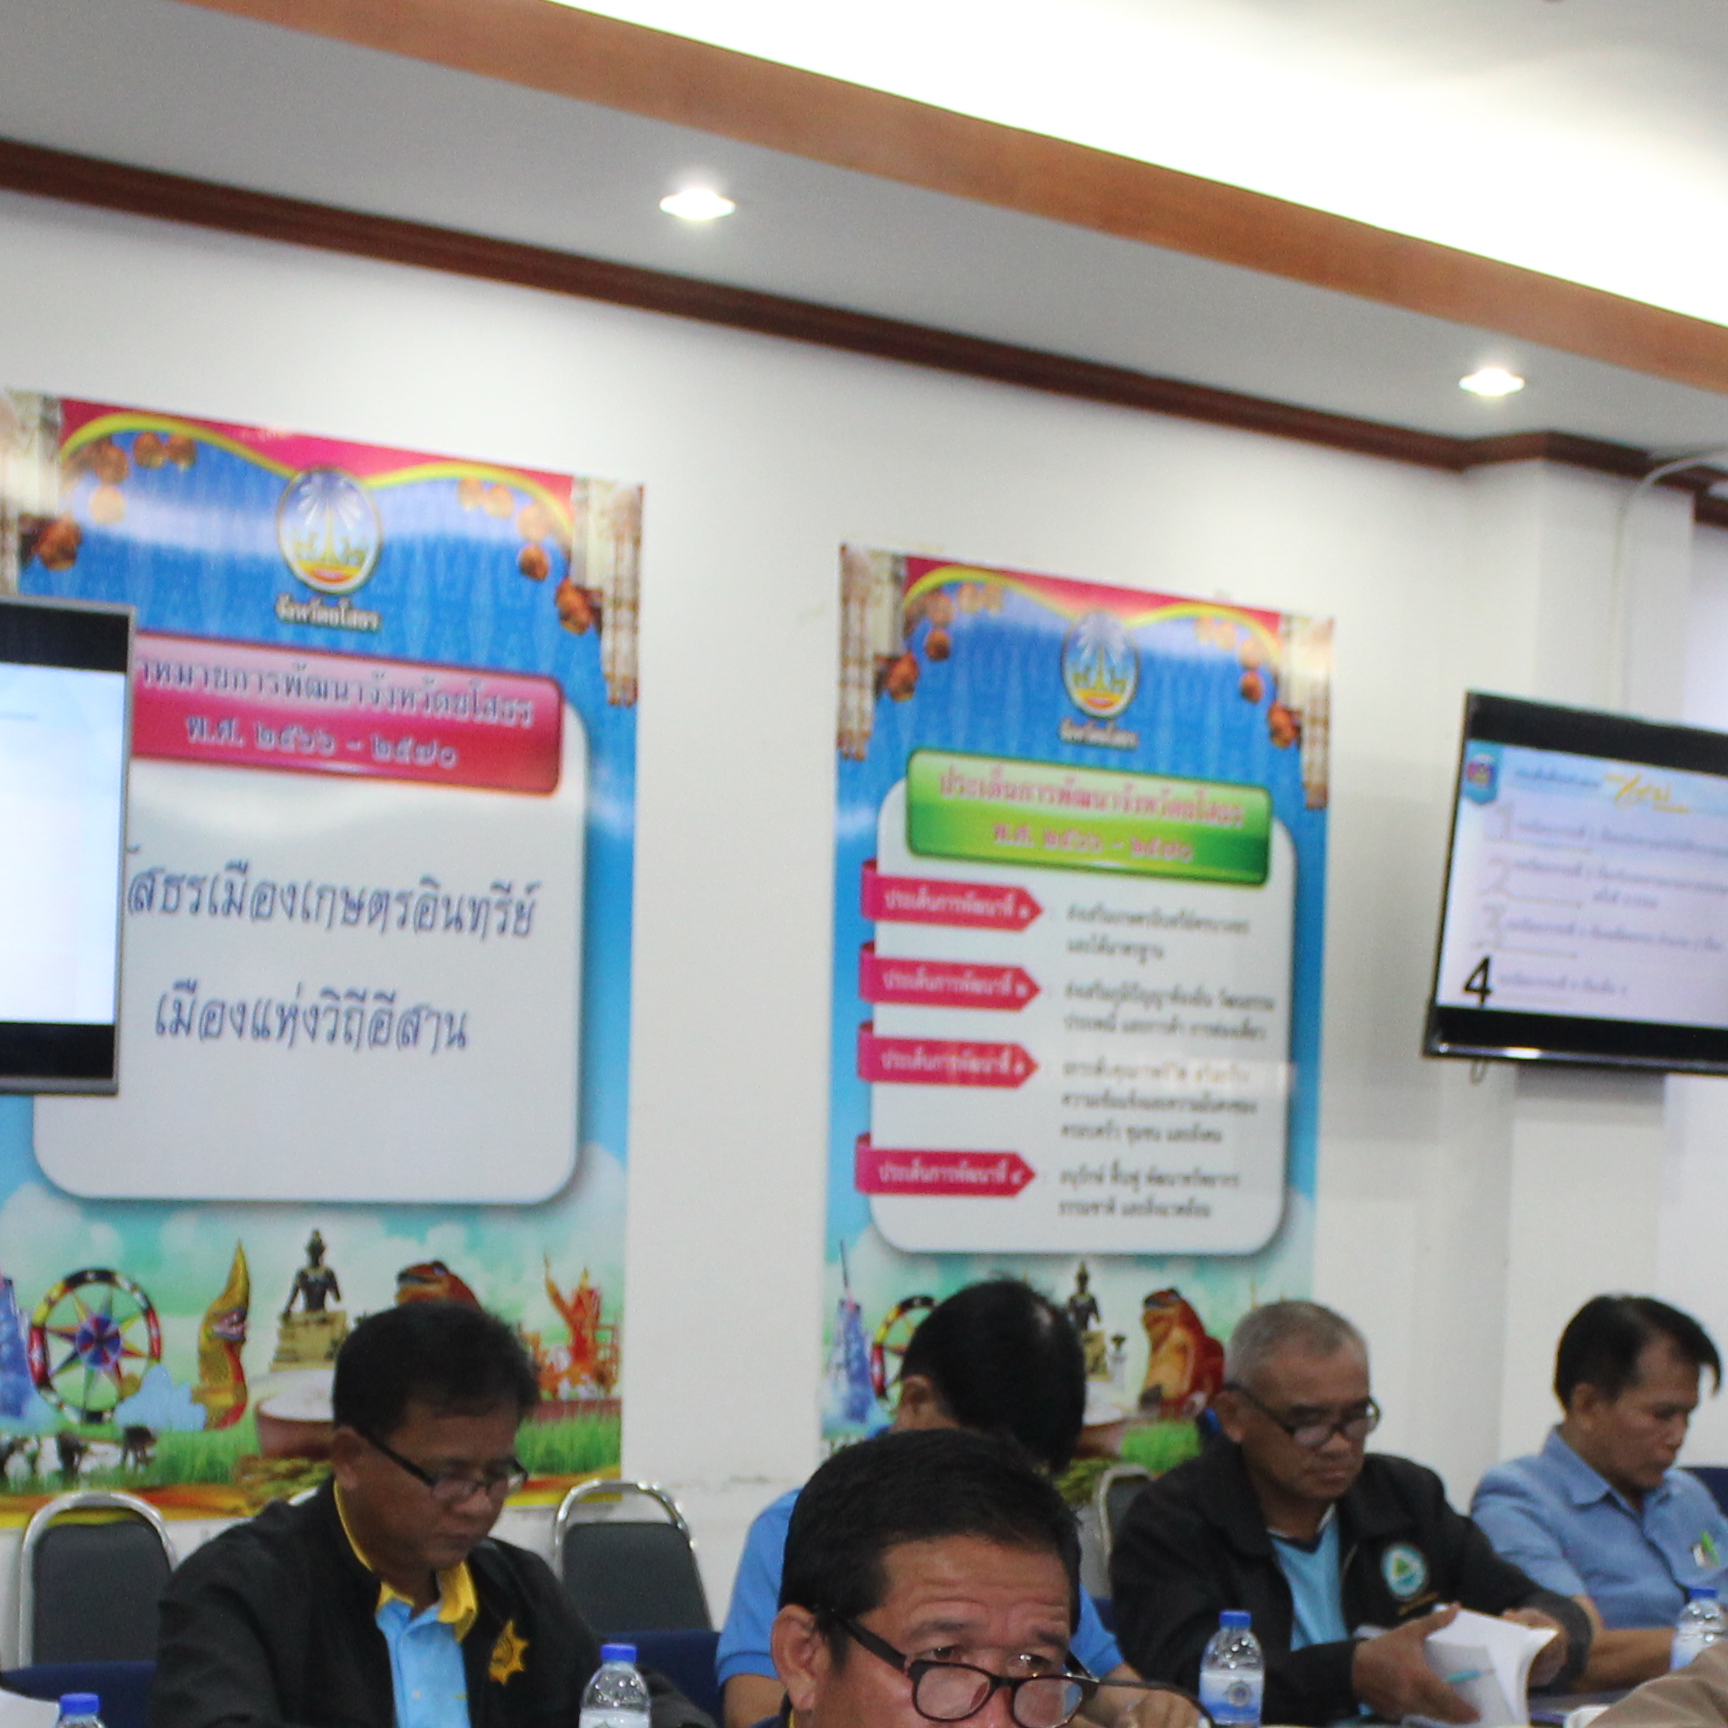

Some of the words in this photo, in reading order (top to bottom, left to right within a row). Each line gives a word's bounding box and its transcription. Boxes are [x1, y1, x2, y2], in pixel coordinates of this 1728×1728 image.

[125, 846, 543, 942] สธรเมืองเกษตรอินทรีย์
[1462, 954, 1493, 1008] 4
